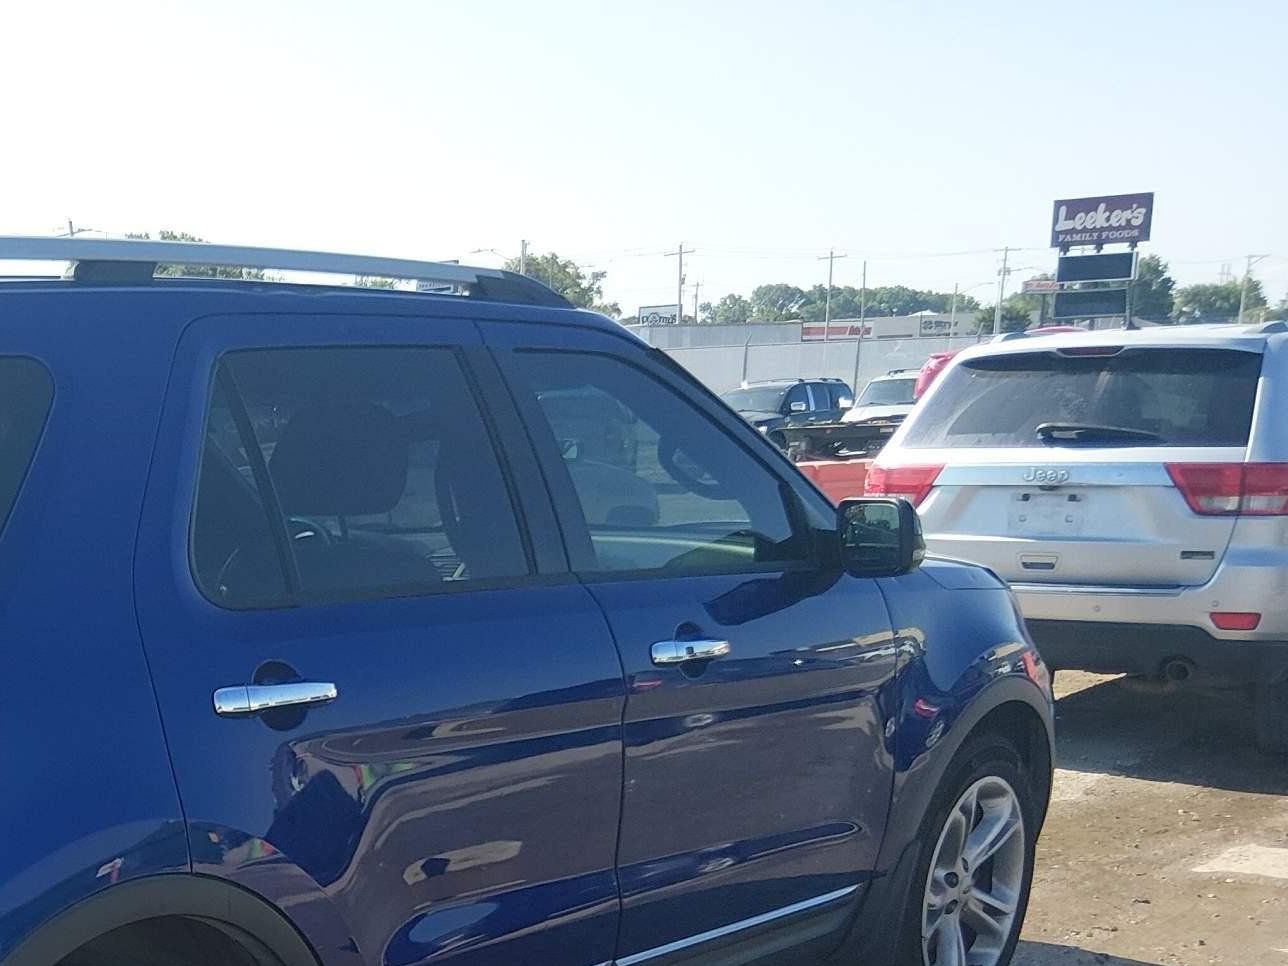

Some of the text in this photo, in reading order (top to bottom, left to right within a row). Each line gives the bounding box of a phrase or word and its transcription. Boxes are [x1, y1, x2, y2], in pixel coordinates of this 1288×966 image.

[1055, 202, 1146, 231] Leeker's
[1059, 229, 1139, 242] FAMILY FOODS
[1023, 467, 1069, 484] Jeep
